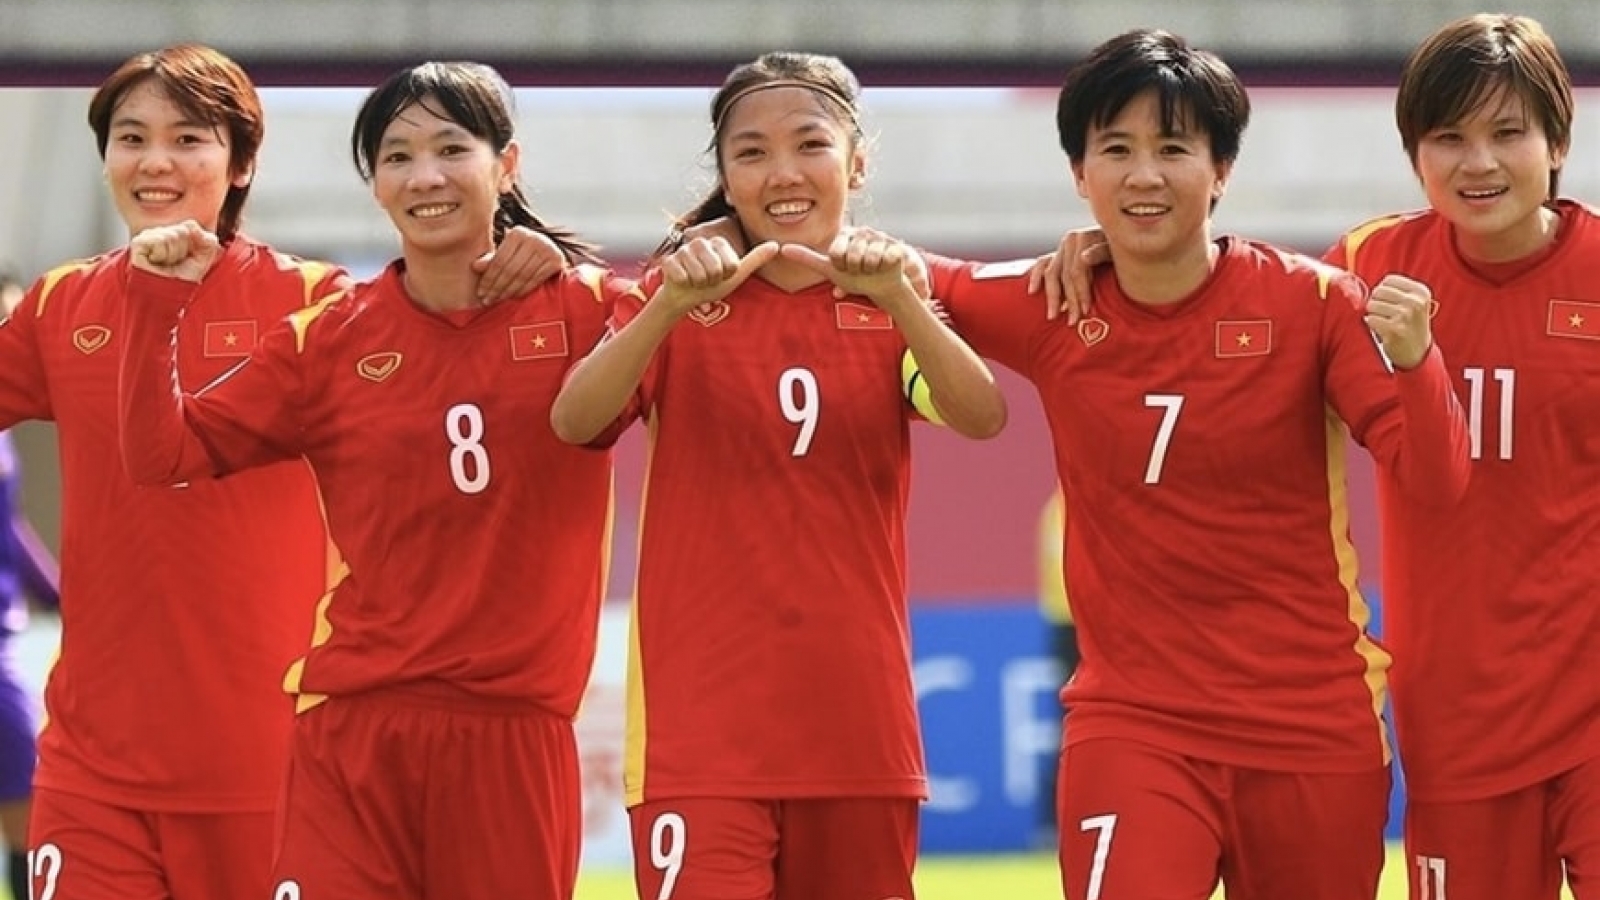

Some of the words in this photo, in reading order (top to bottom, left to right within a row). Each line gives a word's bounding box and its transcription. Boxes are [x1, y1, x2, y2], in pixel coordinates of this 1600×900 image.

[445, 403, 491, 493] 8
[777, 367, 820, 457] 9
[1143, 394, 1185, 485] 7
[1463, 367, 1516, 460] 11
[650, 812, 687, 900] 9
[1080, 813, 1118, 900] 7
